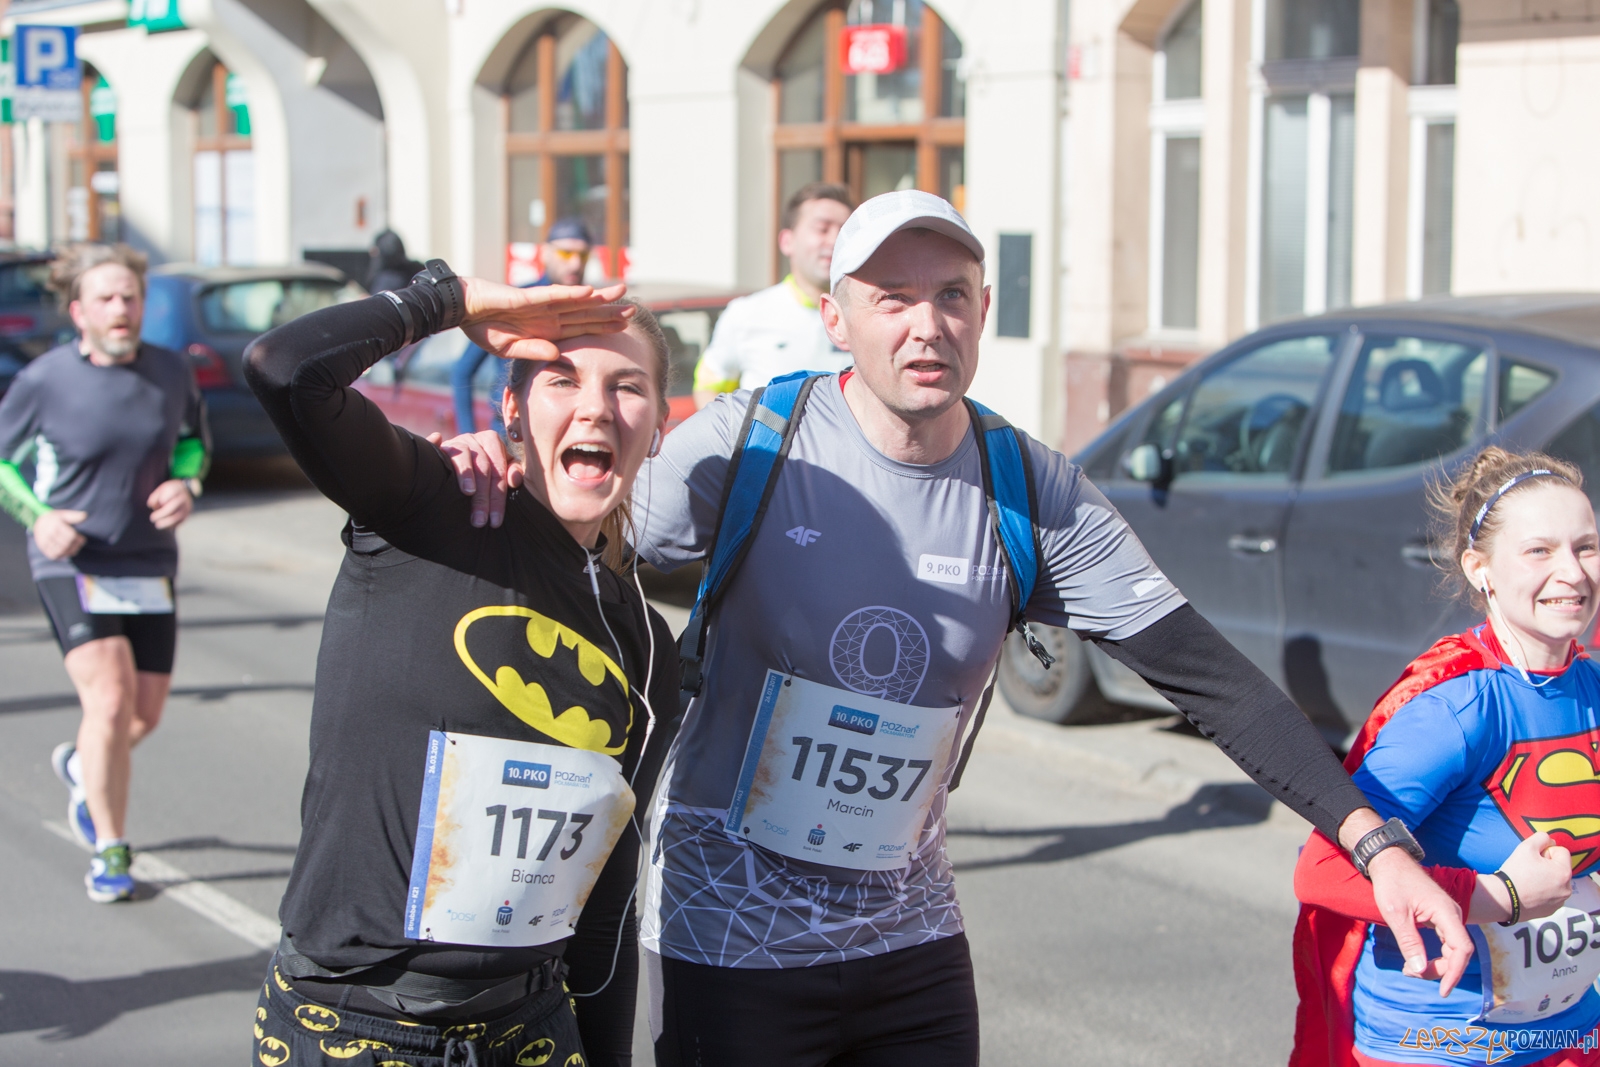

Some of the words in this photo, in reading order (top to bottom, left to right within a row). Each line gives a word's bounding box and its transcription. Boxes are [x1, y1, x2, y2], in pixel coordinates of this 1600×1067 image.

[24, 28, 67, 84] P
[1499, 477, 1516, 495] NIKE
[1476, 502, 1488, 524] NIKE
[786, 526, 821, 547] 4F
[926, 562, 935, 573] 9.
[937, 564, 961, 576] PKO
[836, 712, 849, 724] 10.
[850, 715, 874, 729] PKO
[428, 739, 439, 774] 26.03.2017
[508, 767, 522, 780] 10.
[523, 769, 547, 782] PKO
[792, 736, 933, 802] 11537
[827, 798, 874, 818] Marcin
[486, 804, 594, 862] 1173
[842, 842, 863, 853] 4F
[511, 869, 555, 884] Bianca
[528, 915, 544, 926] 4F
[1552, 965, 1577, 979] Anna
